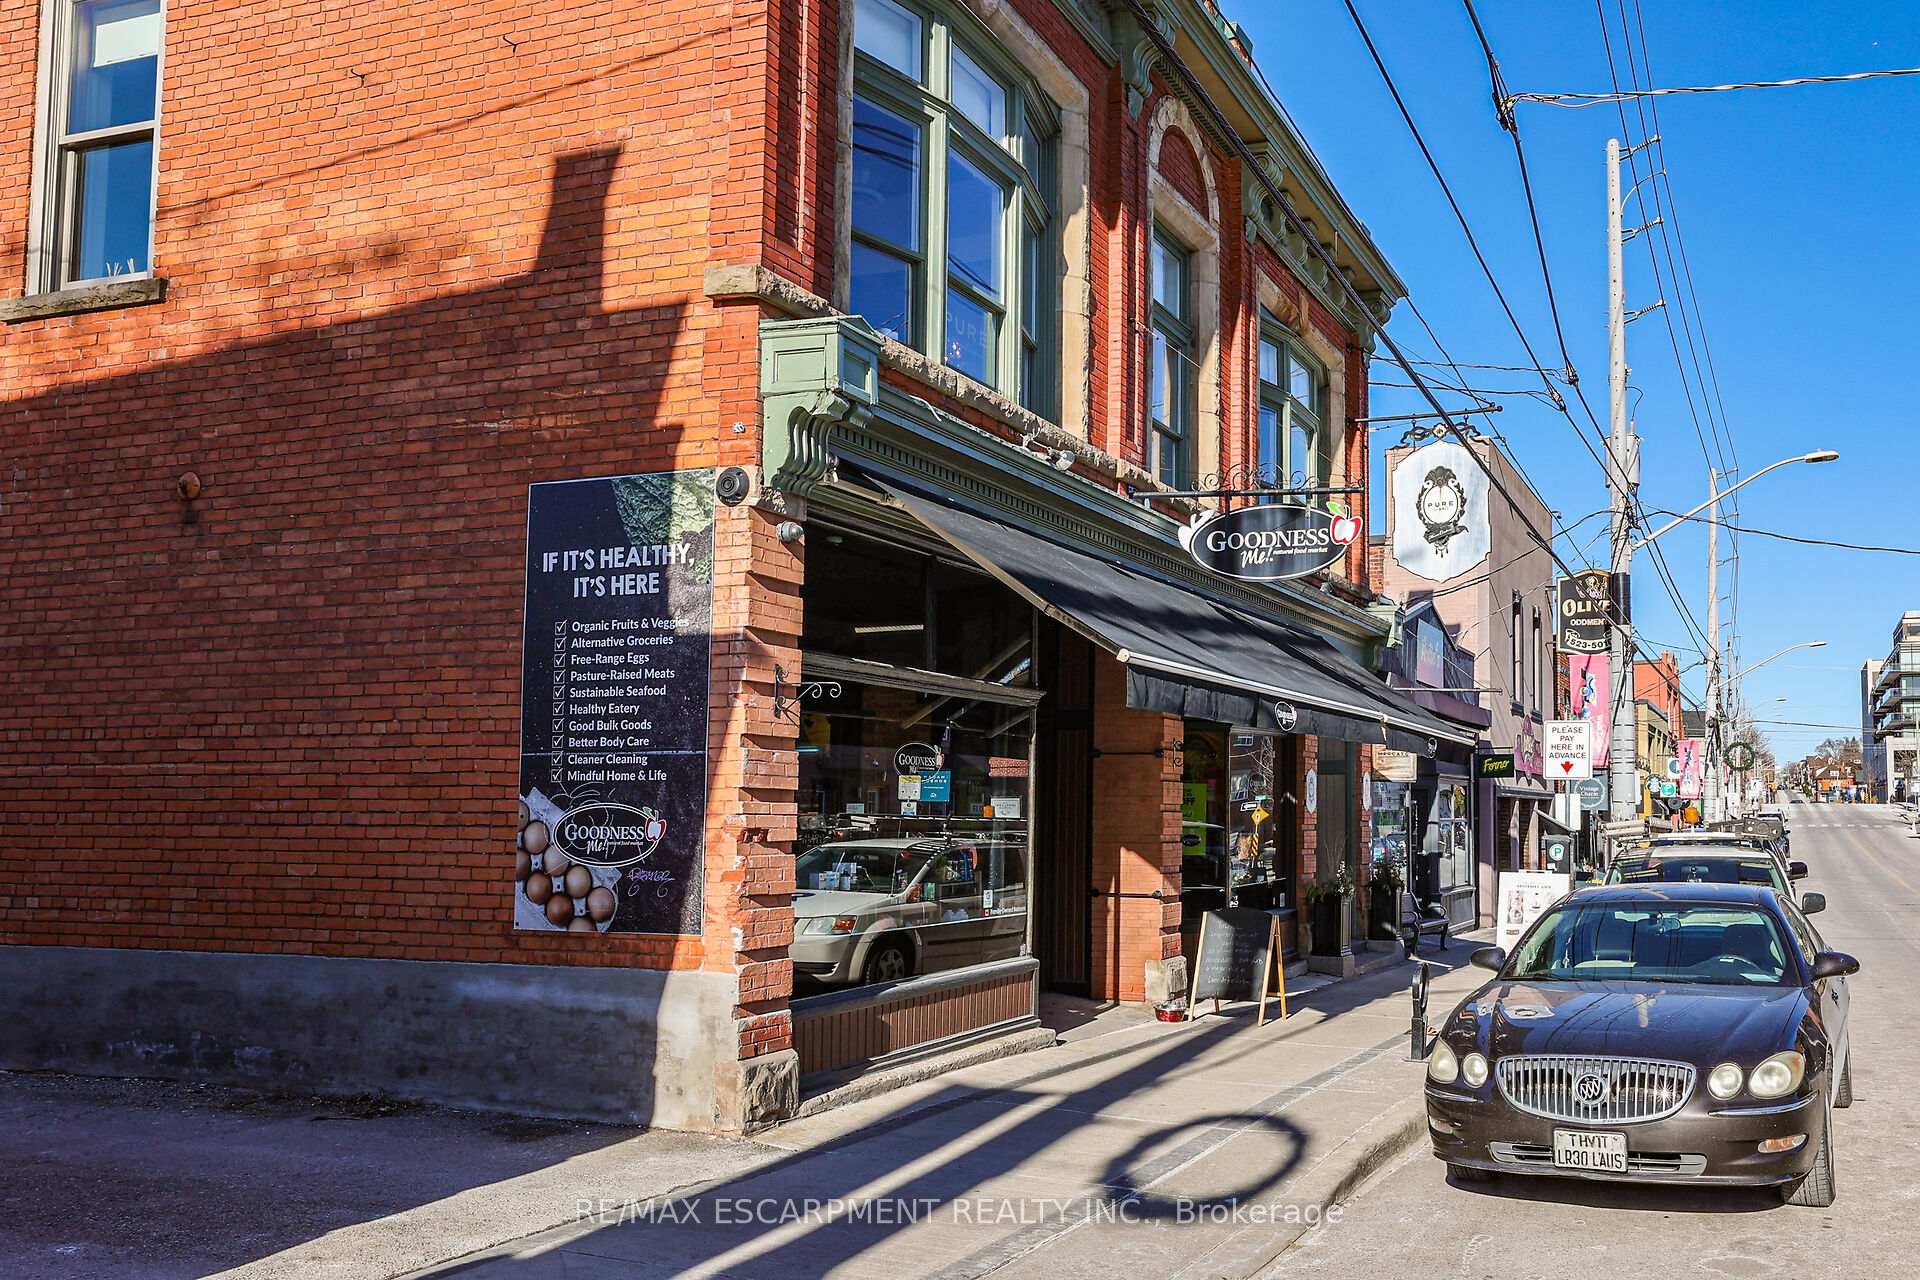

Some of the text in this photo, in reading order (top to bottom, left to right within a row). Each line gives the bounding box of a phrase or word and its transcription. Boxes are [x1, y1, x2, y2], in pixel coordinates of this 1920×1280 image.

[1206, 528, 1330, 552] GOODNESS
[542, 543, 695, 572] IF IT'S HEALTHY,
[573, 572, 660, 598] IT'S HERE
[1562, 598, 1611, 617] OLIVE
[571, 617, 690, 634] Organic Fruits & Veggies
[571, 634, 674, 649] Alternative Groceries
[571, 652, 650, 666] Free-Range Eggs
[570, 668, 676, 681] Pasture-Raised Meats
[569, 684, 667, 698] Sustainable Seafood
[569, 703, 640, 716] Healthy Eatery
[568, 719, 652, 731] Good Bulk Goods
[1551, 726, 1584, 734] PLEASE
[568, 736, 650, 748] Better Body Care
[568, 754, 648, 766] Cleaner Cleaning
[898, 753, 936, 767] GOODNESS
[567, 770, 667, 781] Mindful Home & Life
[565, 823, 645, 841] GOODNESS
[1554, 847, 1562, 856] P
